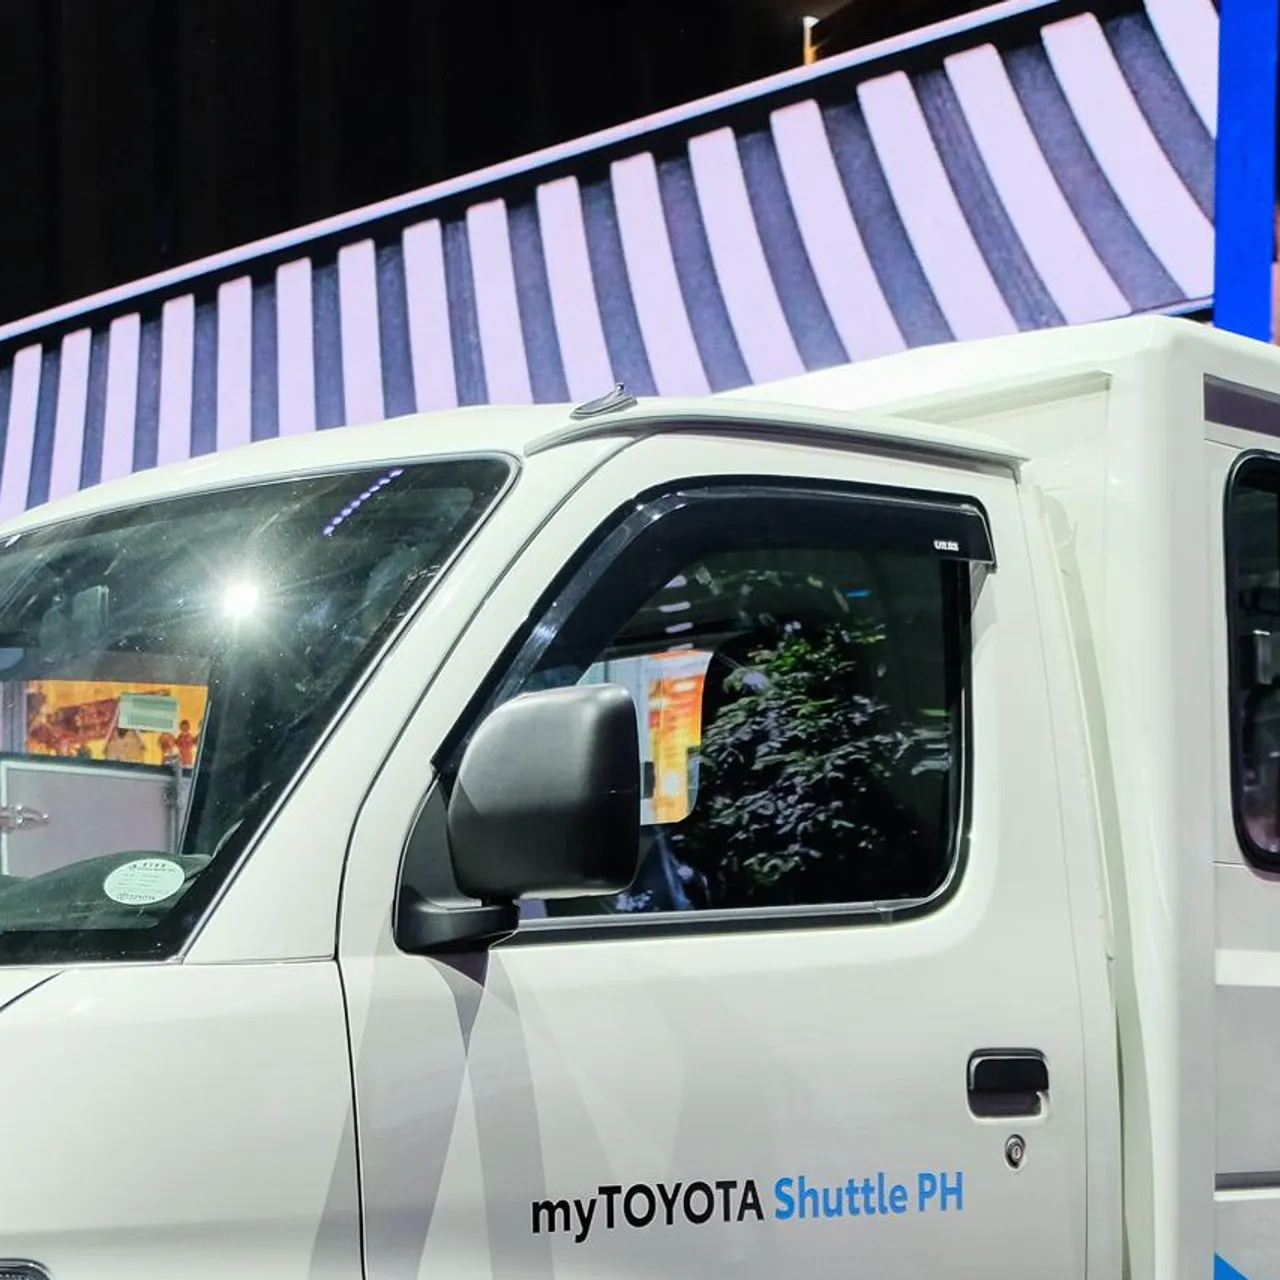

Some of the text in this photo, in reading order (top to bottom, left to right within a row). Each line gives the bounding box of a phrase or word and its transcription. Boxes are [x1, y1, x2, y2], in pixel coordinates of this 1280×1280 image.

[531, 1170, 964, 1244] myTOYOTA Shuttle PH
